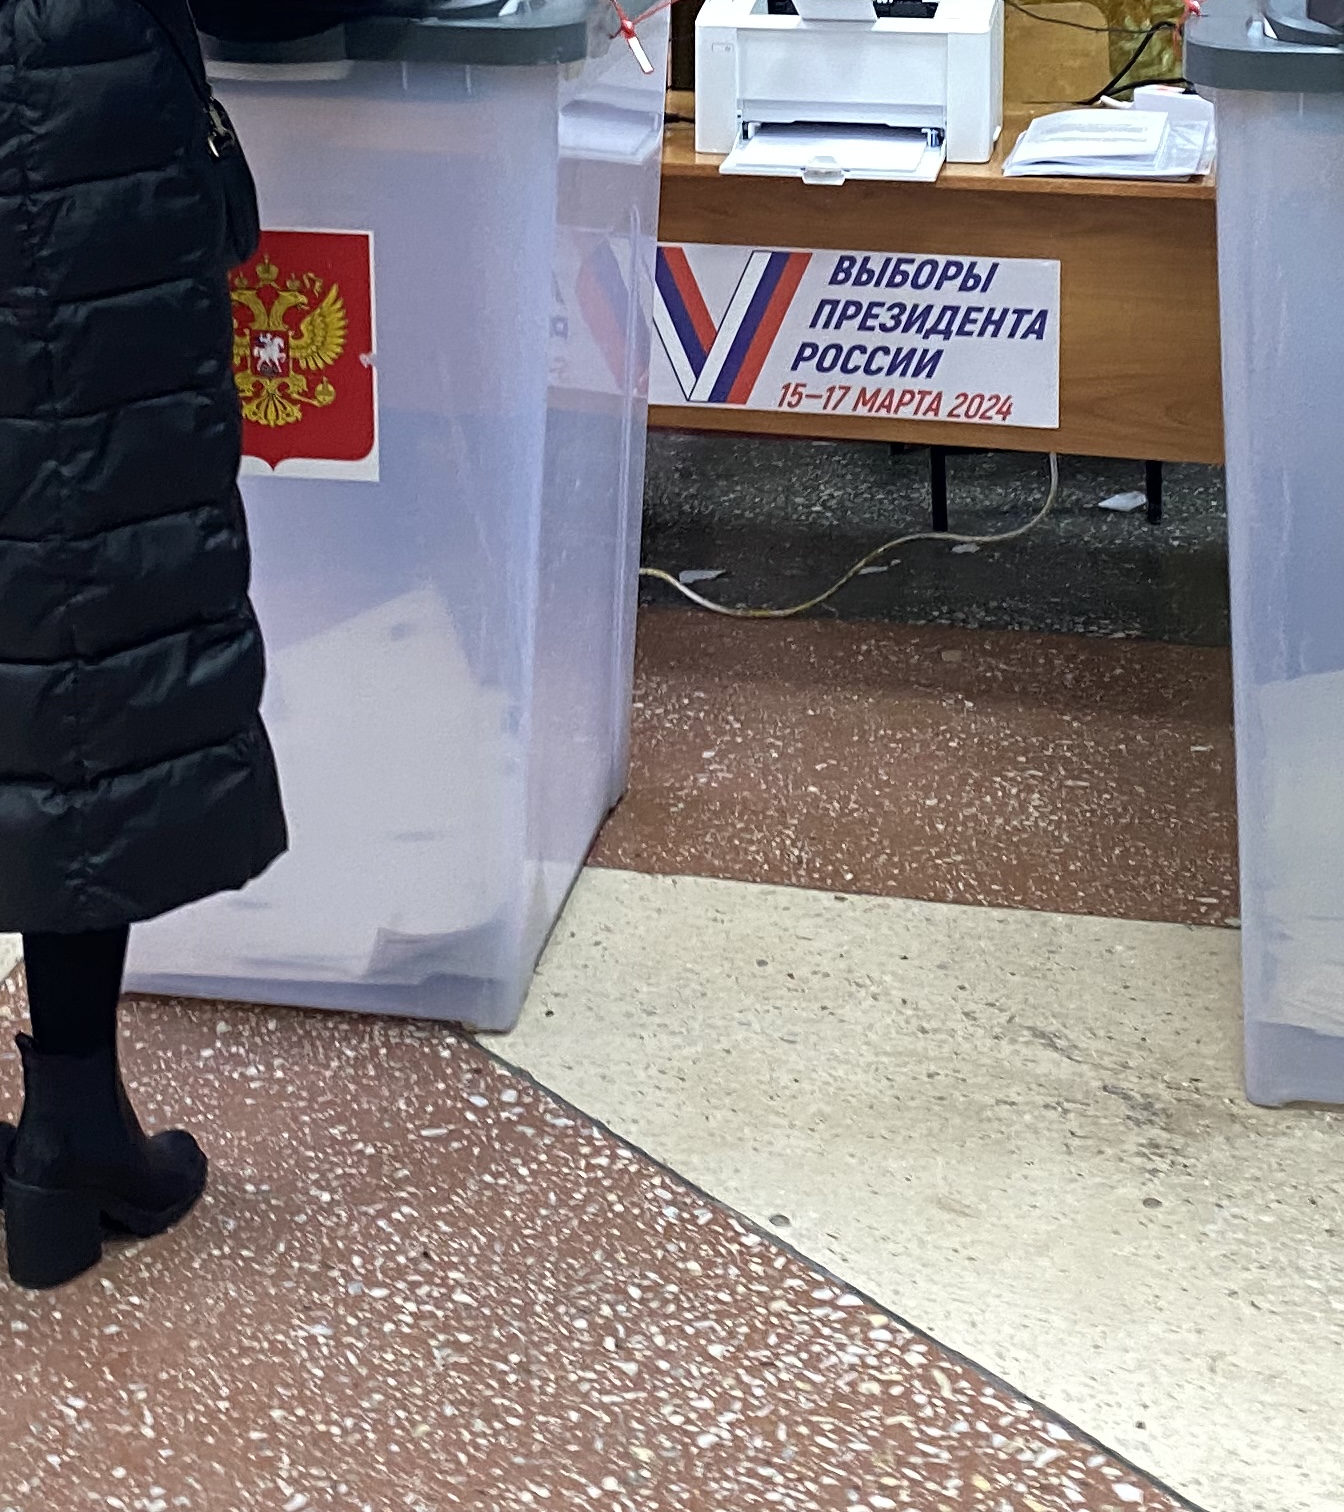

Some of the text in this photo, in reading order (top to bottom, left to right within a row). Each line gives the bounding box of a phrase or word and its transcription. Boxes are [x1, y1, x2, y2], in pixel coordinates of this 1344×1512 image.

[827, 254, 1000, 294] ВЫБОРЫ
[808, 299, 1049, 341] ПРЕЗИДЕНТА
[790, 342, 945, 379] РОССИИ
[852, 387, 944, 418] МАРТА
[947, 394, 1014, 422] 2024
